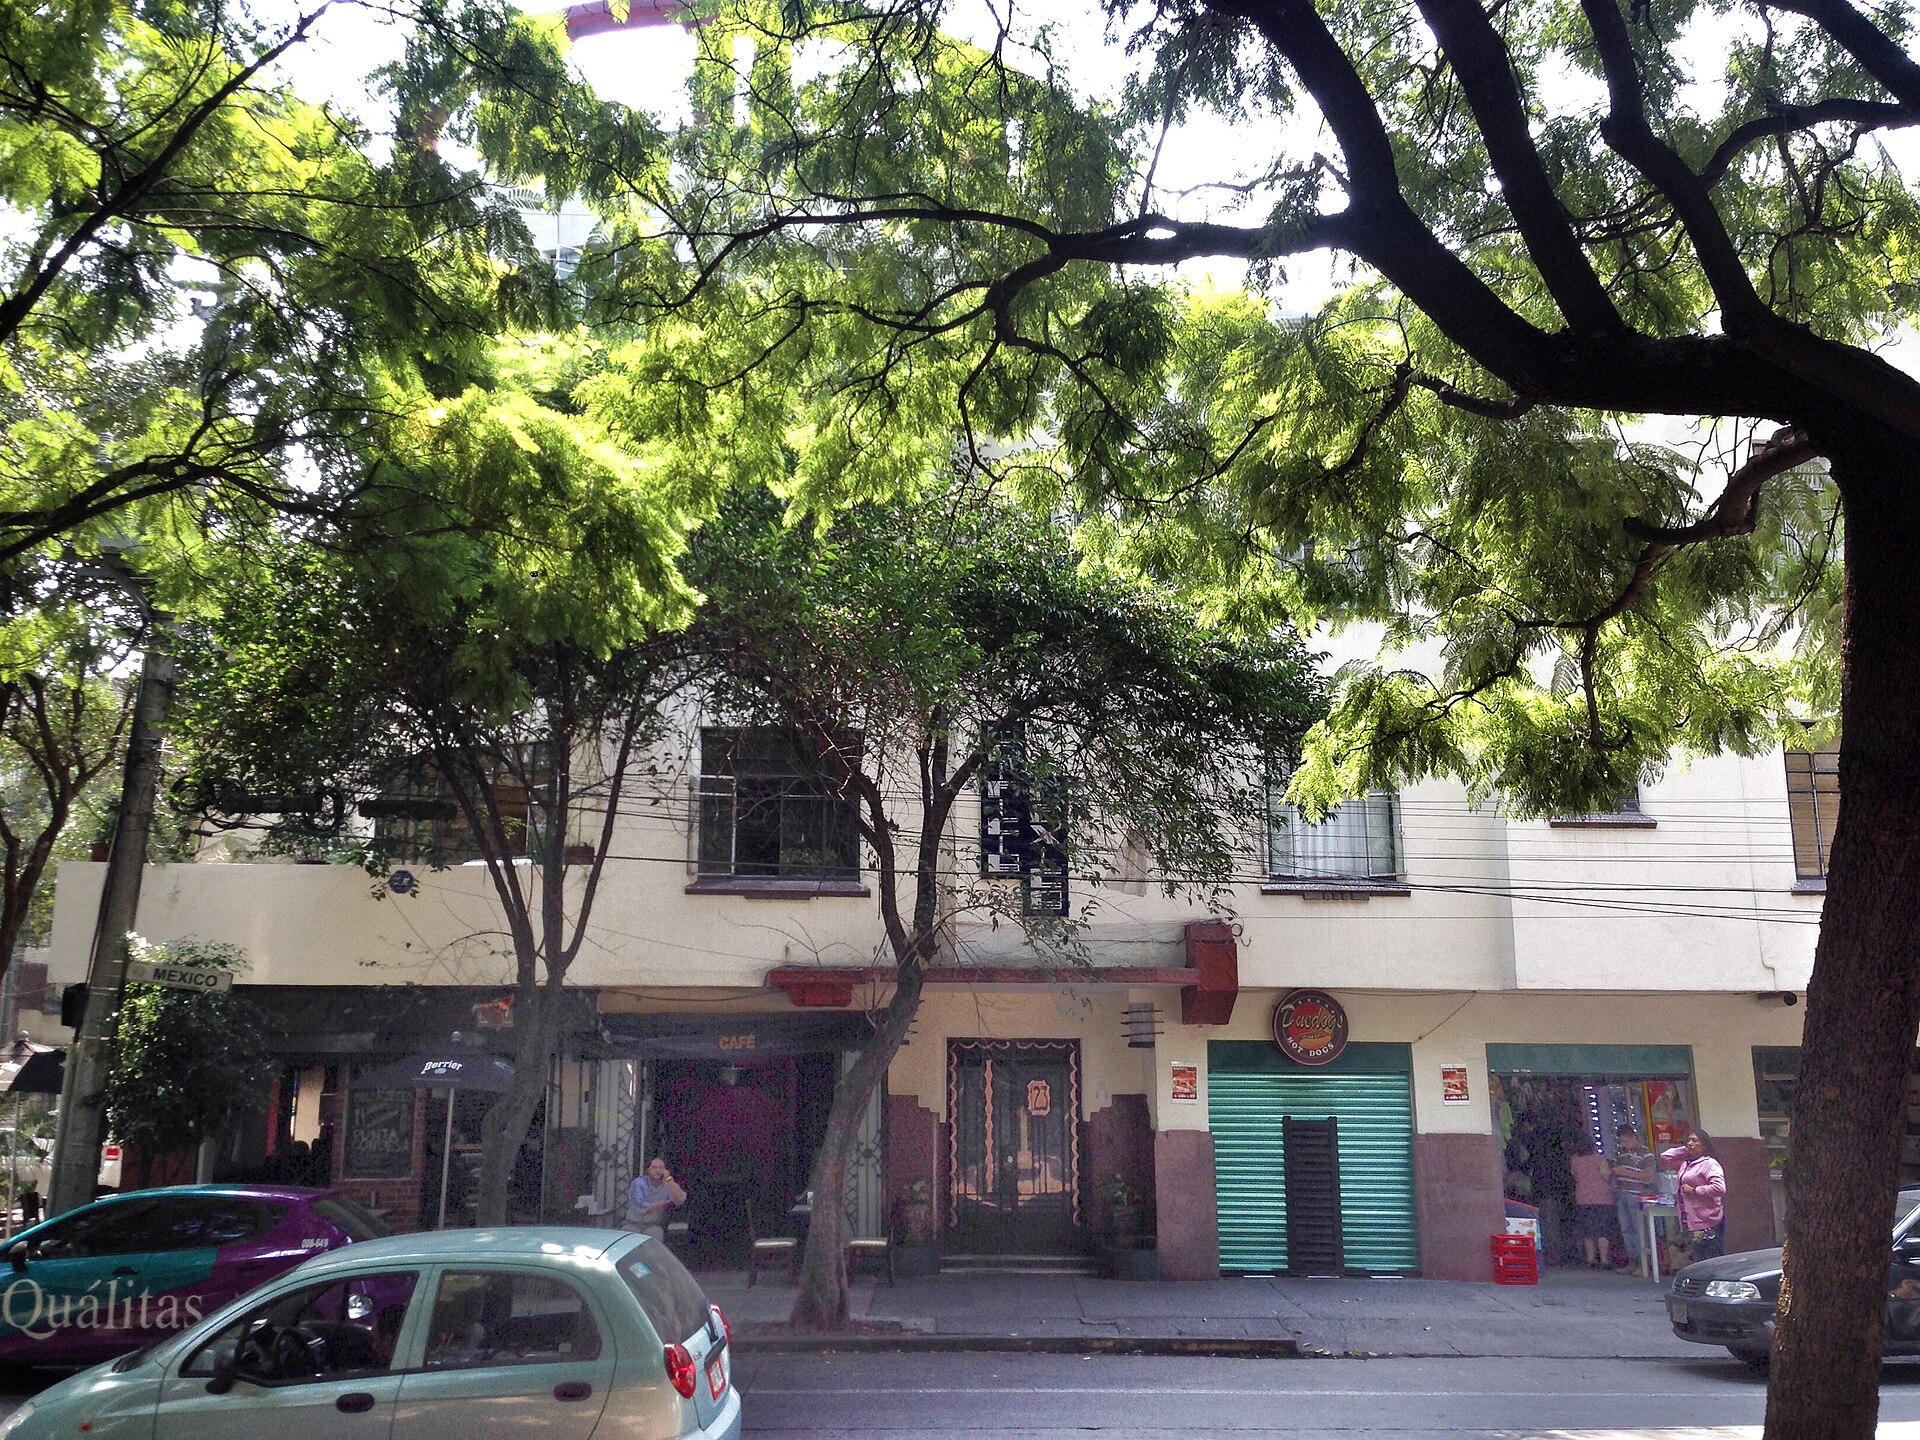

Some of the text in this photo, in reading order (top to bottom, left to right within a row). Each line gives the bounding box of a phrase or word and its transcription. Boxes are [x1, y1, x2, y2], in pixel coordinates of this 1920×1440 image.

[152, 968, 218, 987] MEXICO
[1286, 1036, 1334, 1056] HOT DOGS
[2, 1278, 204, 1340] Quálitas
